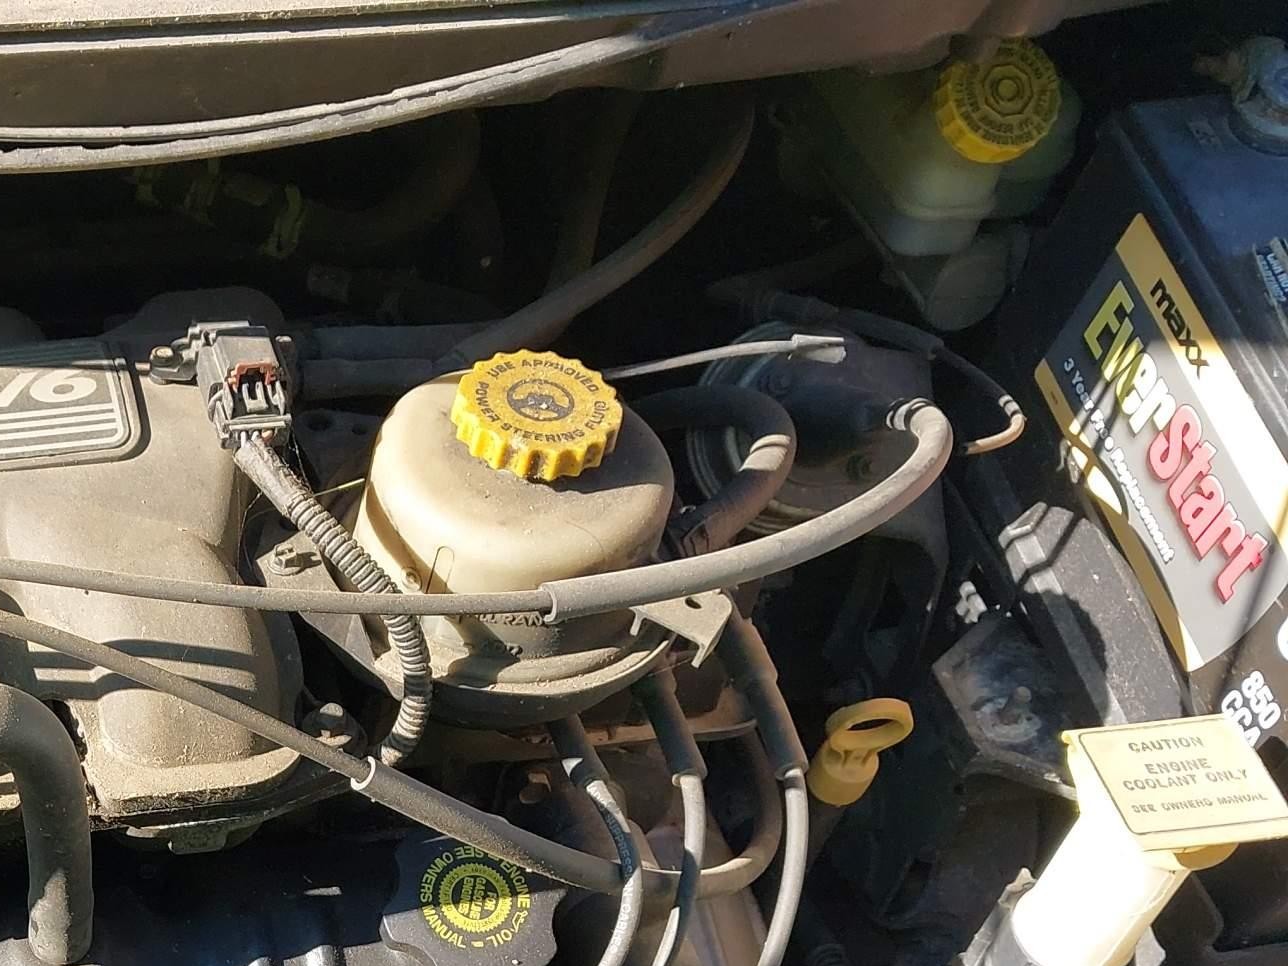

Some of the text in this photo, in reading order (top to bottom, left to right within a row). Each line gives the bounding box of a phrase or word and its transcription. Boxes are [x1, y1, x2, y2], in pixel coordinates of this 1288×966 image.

[1149, 278, 1210, 379] maxx
[500, 421, 585, 443] STEERING
[1064, 358, 1075, 372] 3
[1071, 370, 1095, 411] Year
[1110, 447, 1175, 564] Replacement
[1241, 671, 1282, 729] 850
[1128, 736, 1204, 753] CAUTION
[1144, 758, 1212, 775] ENGINE
[1123, 768, 1248, 791] COOLANT ONLY
[1218, 791, 1269, 805] MANUAL
[454, 845, 485, 859] SEE
[420, 851, 454, 903] OWNERS
[457, 877, 474, 914] ENGINES
[484, 891, 497, 911] FOR
[421, 904, 467, 949] MANUAL
[486, 929, 513, 947] OIL
